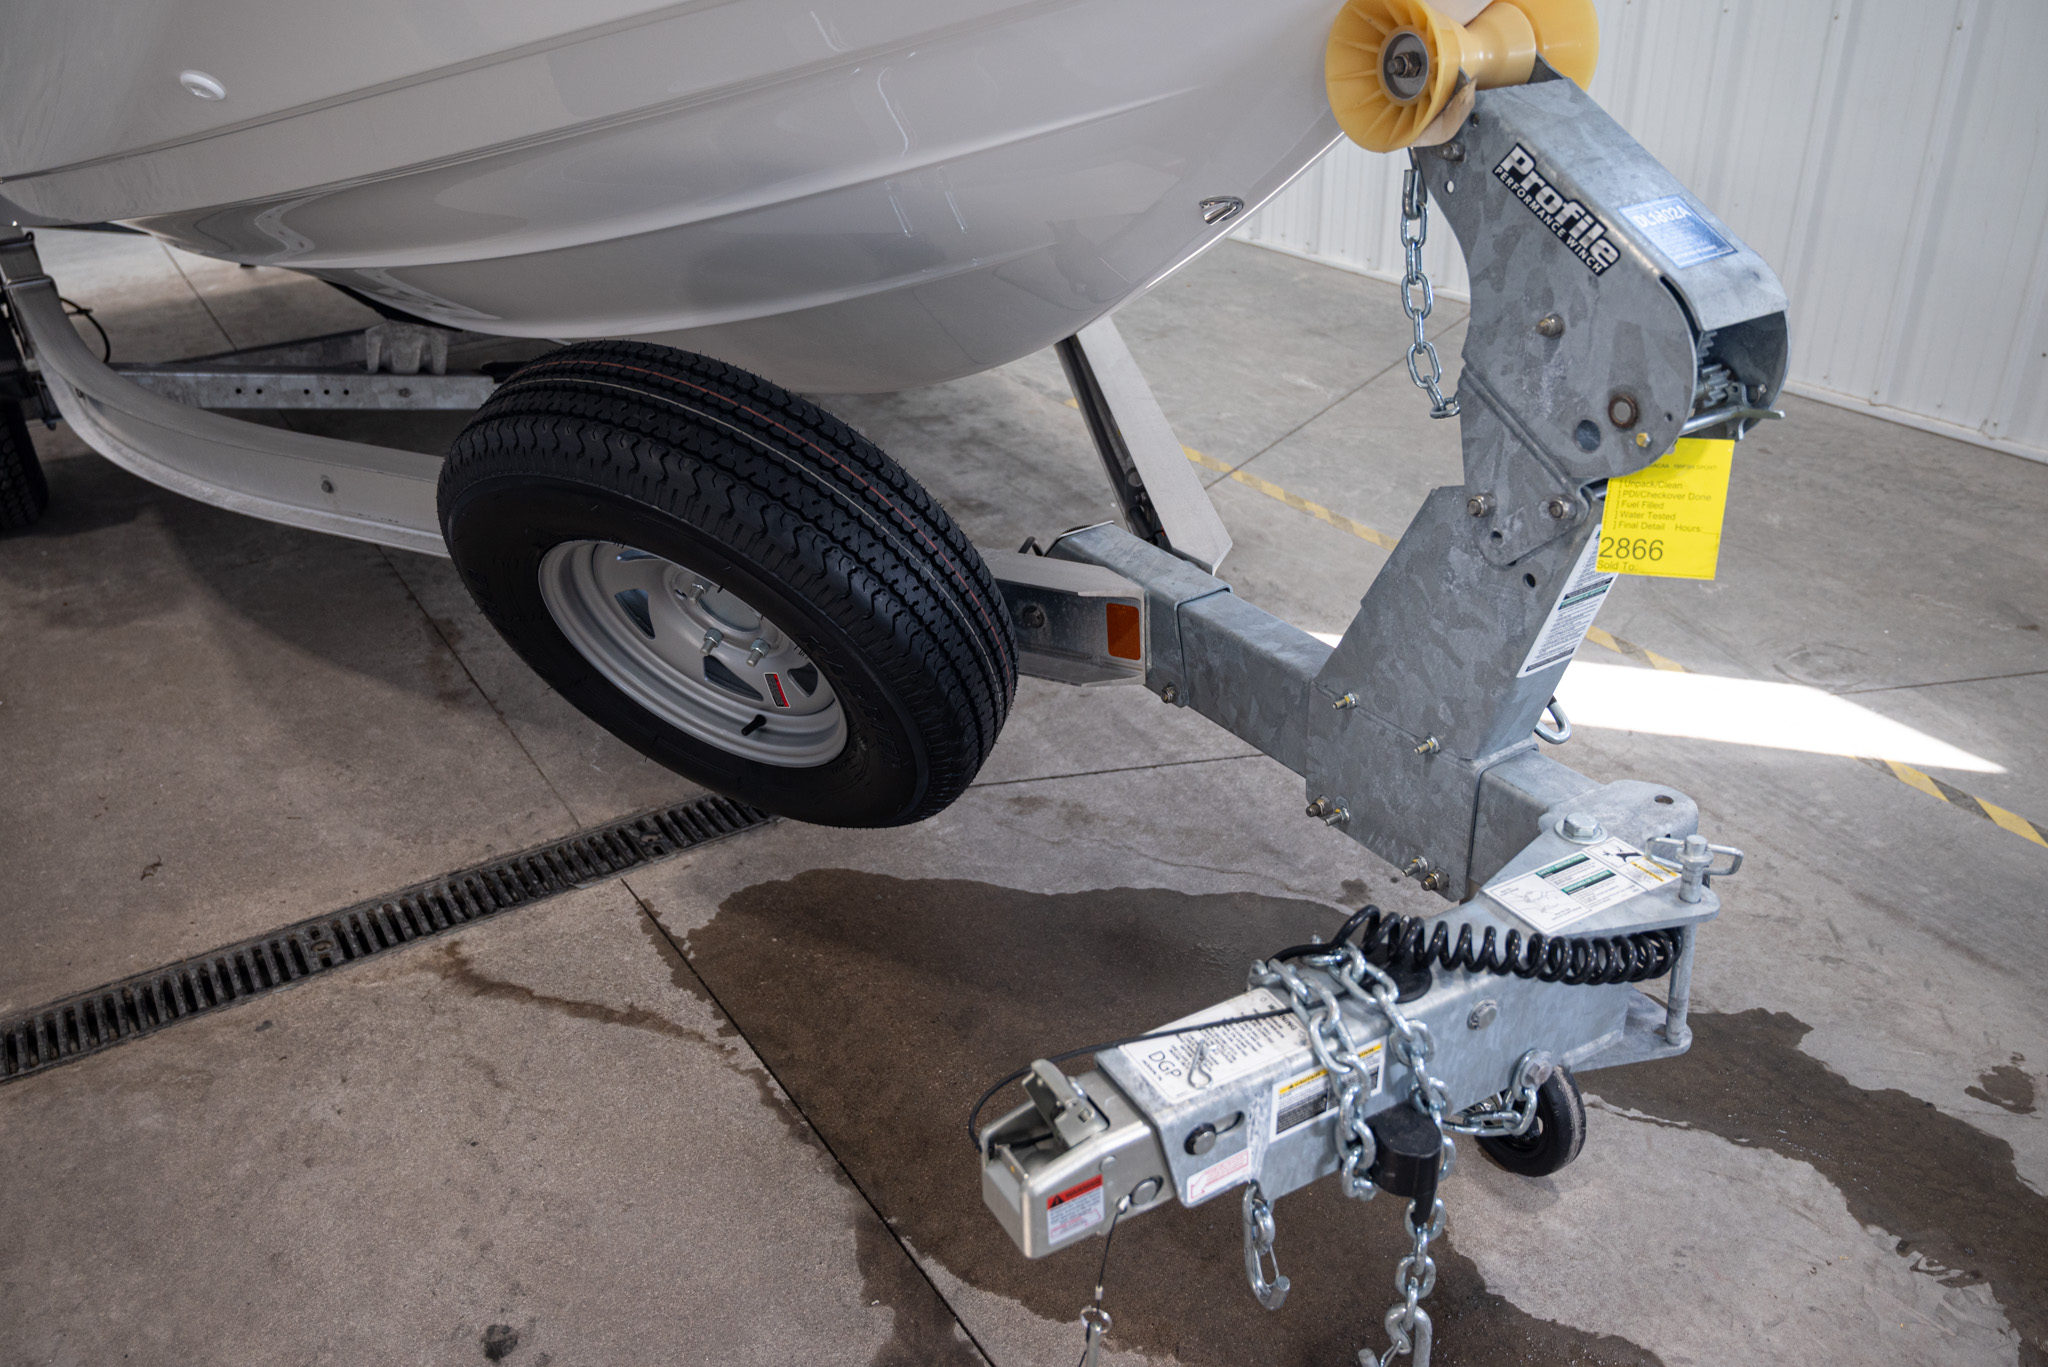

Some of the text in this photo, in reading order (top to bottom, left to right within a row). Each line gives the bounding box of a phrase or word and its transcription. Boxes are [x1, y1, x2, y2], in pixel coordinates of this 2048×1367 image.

[1500, 145, 1618, 268] Profile
[1494, 166, 1567, 238] PERFORMANCE
[1566, 236, 1603, 274] WINCH
[1624, 479, 1683, 490] Unpack/Clean
[1622, 490, 1712, 501] PDI/Checkover Done
[1621, 500, 1665, 510] Fuel Filled
[1620, 510, 1676, 521] Water Tested
[1618, 521, 1638, 529] Final
[1641, 522, 1665, 530] Detail
[1599, 536, 1664, 561] 2866
[1597, 560, 1619, 570] Sold
[1148, 1050, 1182, 1077] DGP
